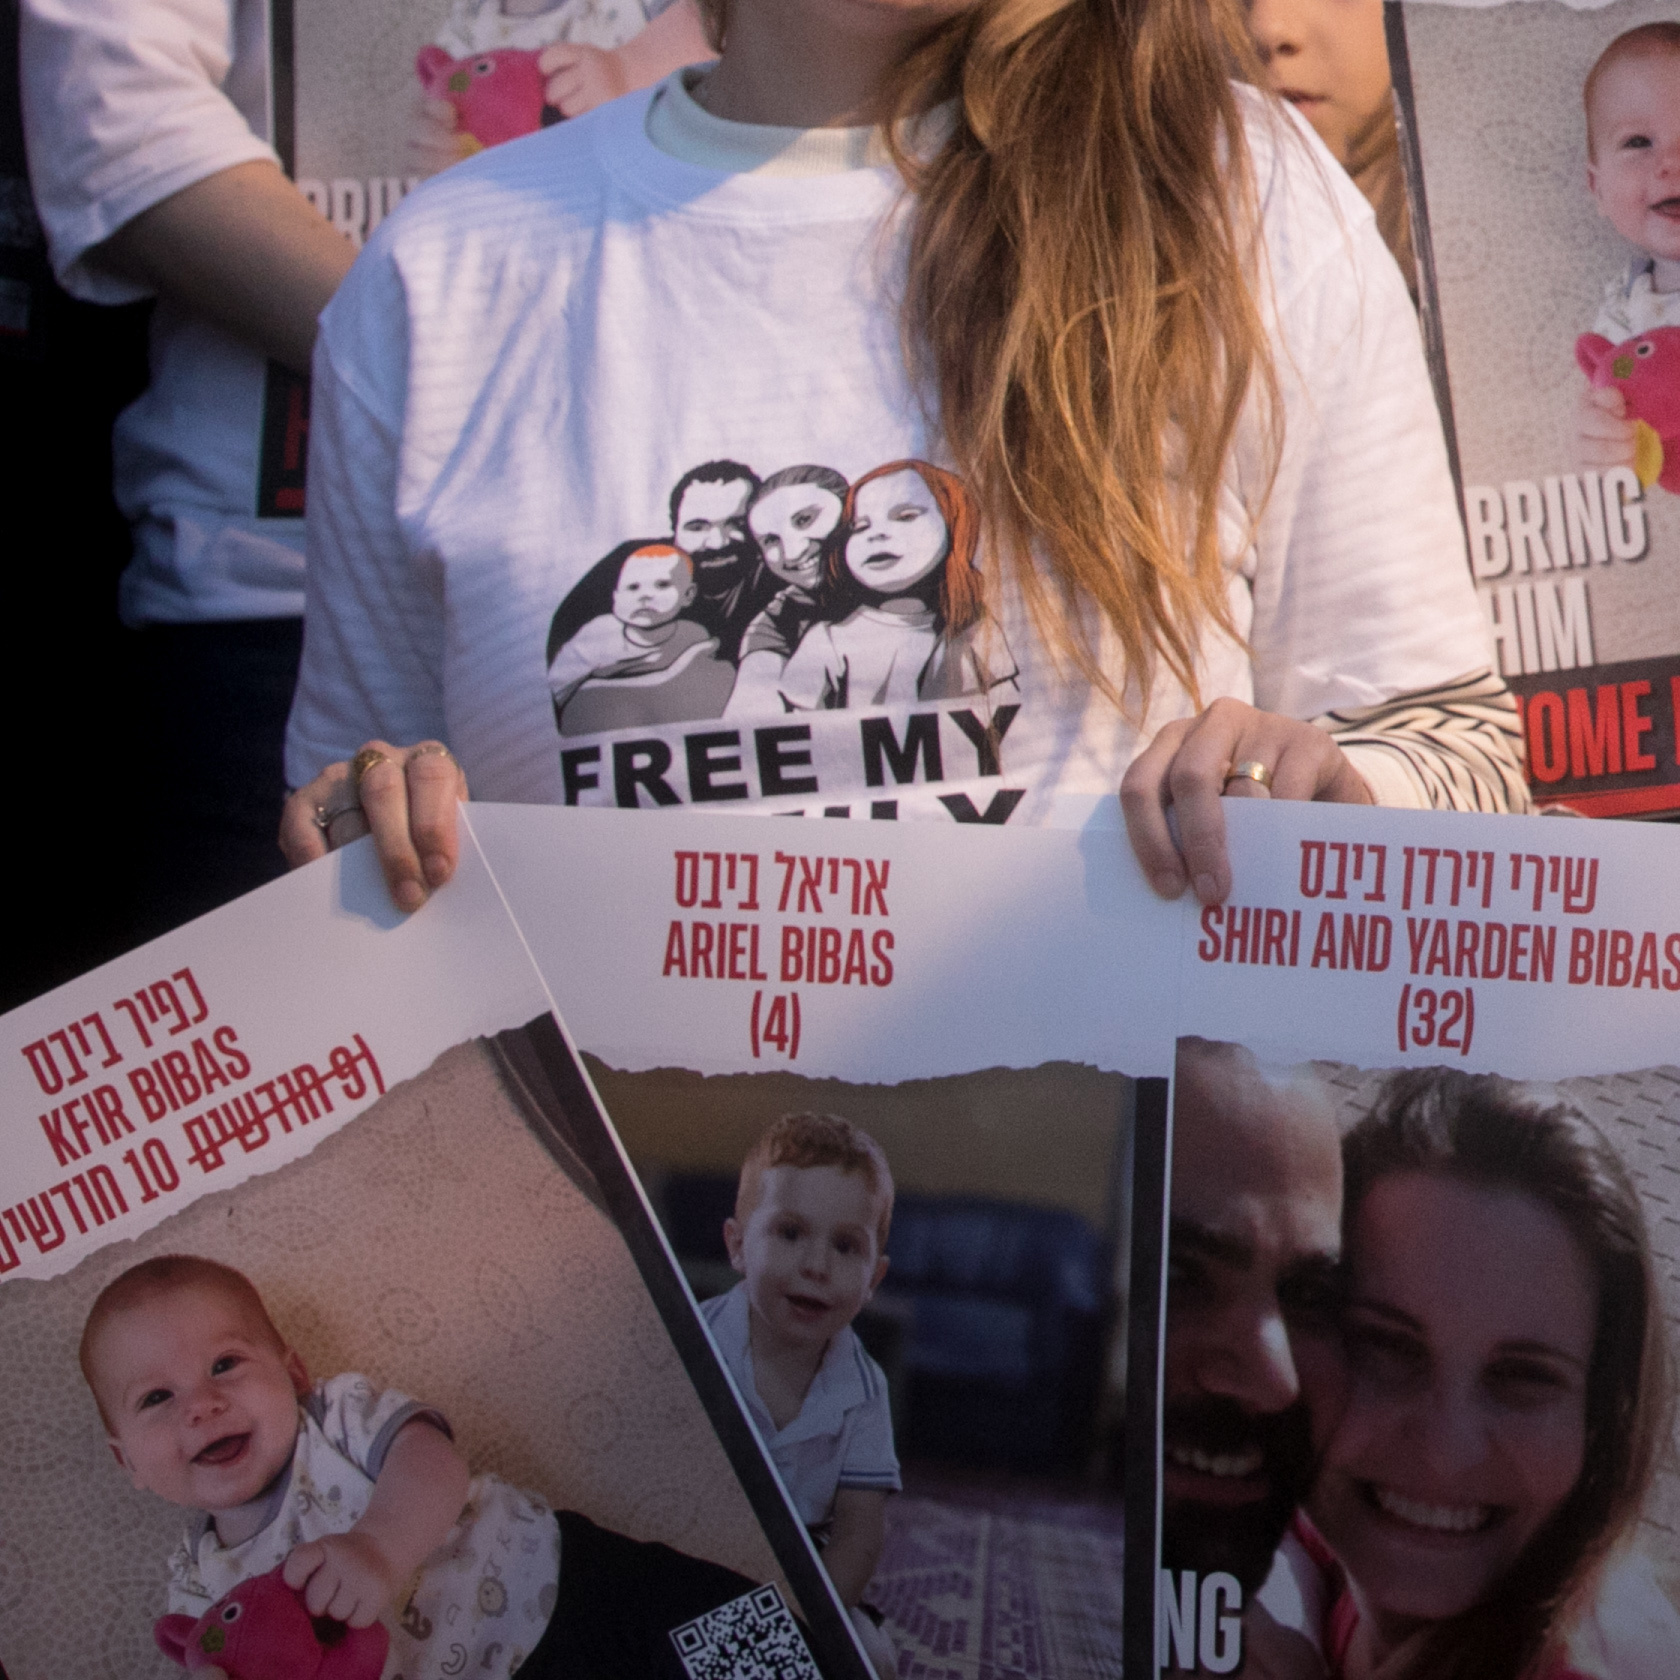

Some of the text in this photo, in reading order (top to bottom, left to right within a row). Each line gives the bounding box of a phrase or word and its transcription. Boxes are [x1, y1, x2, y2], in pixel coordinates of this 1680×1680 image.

[1465, 466, 1649, 581] BRING
[1489, 577, 1594, 677] HIM
[560, 723, 819, 810] FREE
[860, 703, 1022, 788] MY
[1524, 678, 1656, 786] OME
[674, 850, 891, 917] אריאל ביבס
[1299, 839, 1600, 916] שירי וירדן ביבס
[662, 920, 895, 988] ARIEL BIBAS
[1197, 903, 1302, 968] SHIRI
[1311, 911, 1394, 973] AND
[1406, 916, 1557, 984] YARDEN
[20, 966, 210, 1096] כפיר ביבס
[750, 989, 802, 1060] (4)
[1397, 983, 1475, 1057] (32)
[38, 1024, 252, 1168] KFIR BIBAS
[122, 1137, 181, 1204] 10
[0, 1163, 130, 1275] חודשי
